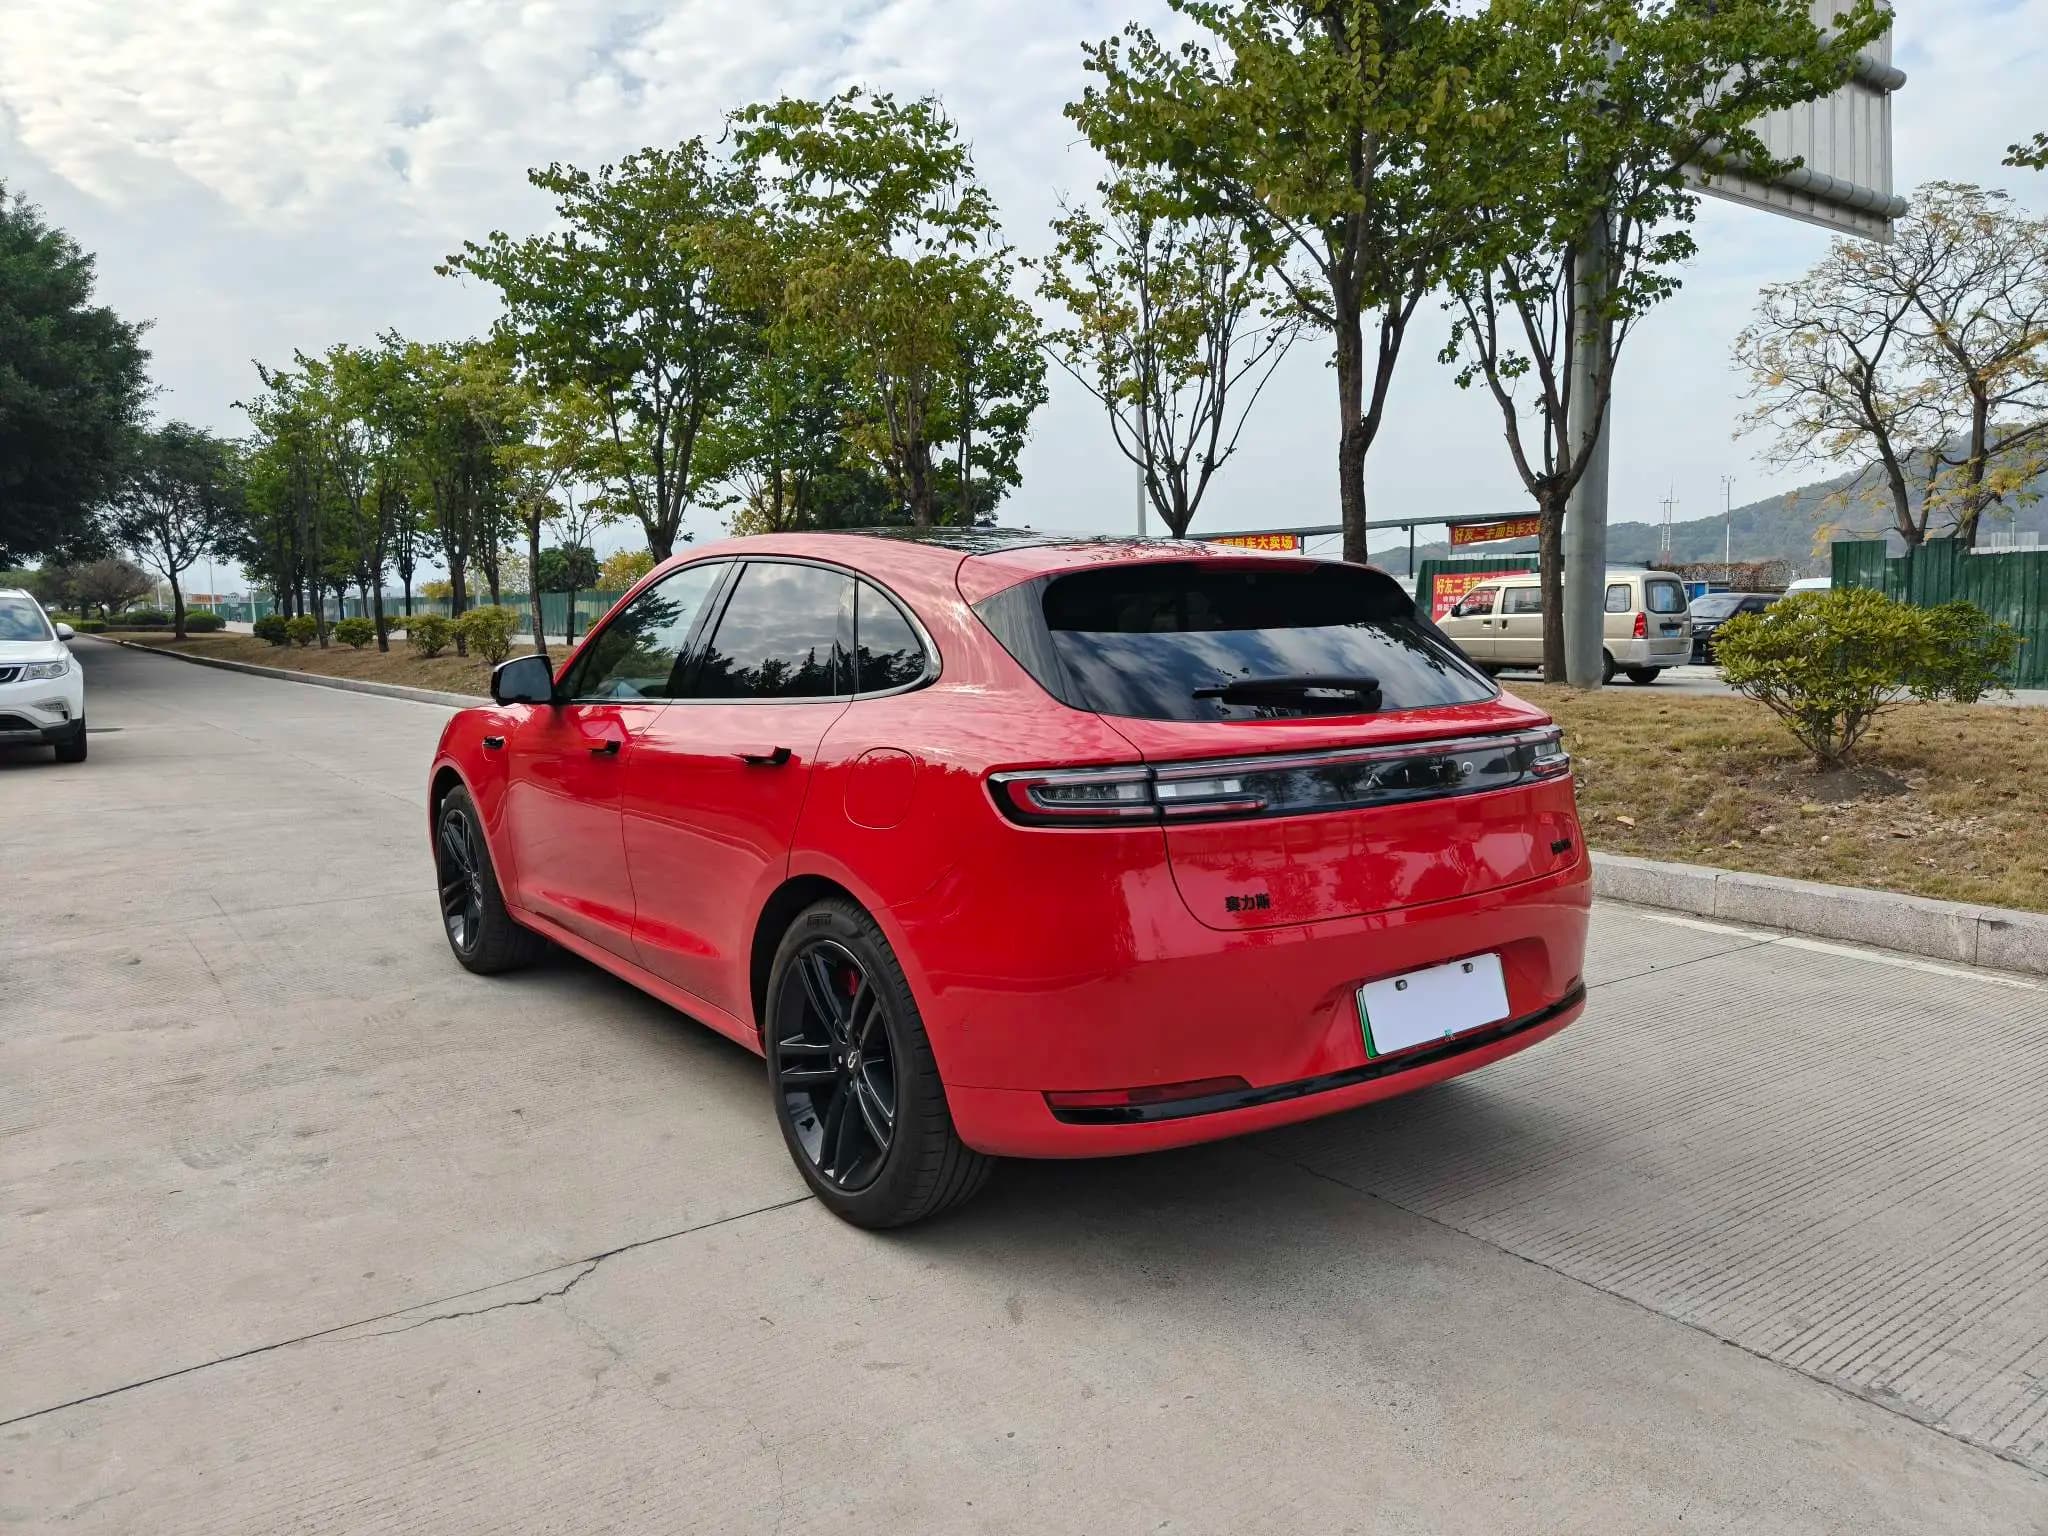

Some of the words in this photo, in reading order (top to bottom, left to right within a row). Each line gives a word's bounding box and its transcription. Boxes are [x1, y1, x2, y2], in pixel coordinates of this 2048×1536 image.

[1366, 761, 1474, 787] AITO
[1224, 893, 1270, 912] 赛力斯
